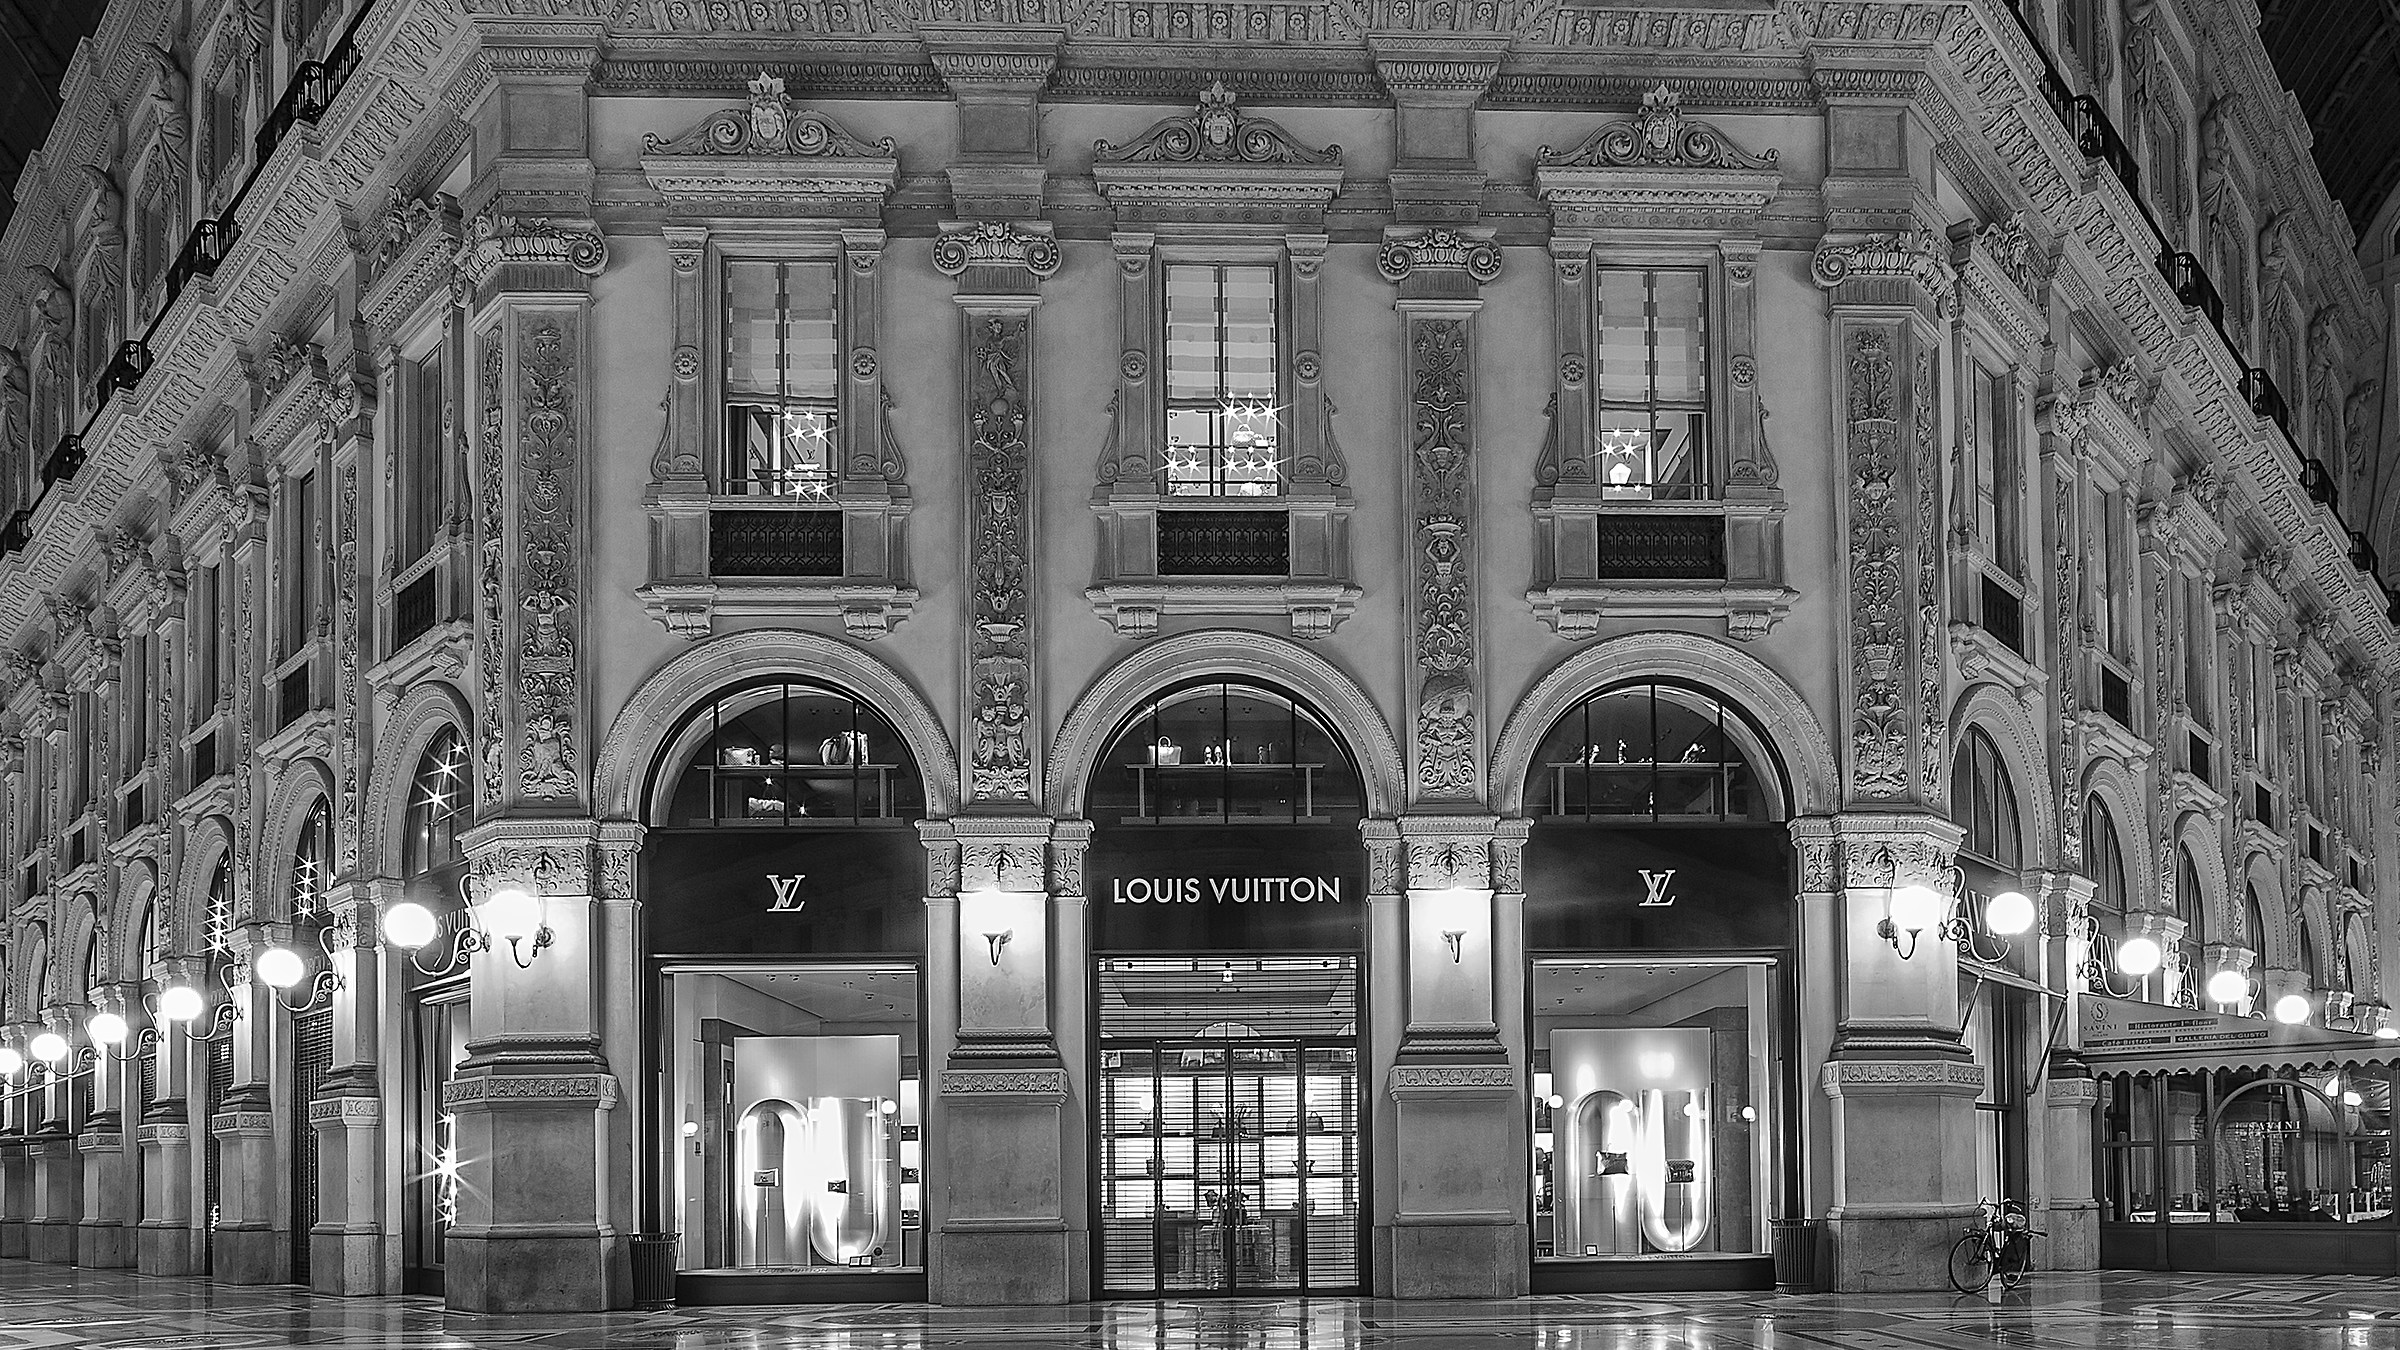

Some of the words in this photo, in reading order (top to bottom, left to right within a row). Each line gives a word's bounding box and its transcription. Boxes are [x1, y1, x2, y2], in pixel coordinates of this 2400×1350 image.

[1113, 877, 1200, 904] LOUIS
[1208, 876, 1341, 904] VUITTON
[2083, 1023, 2117, 1032] SAVINI
[2134, 1021, 2178, 1029] Ristorante
[2177, 1032, 2218, 1041] GALLERIA
[2219, 1032, 2236, 1040] DEL
[2237, 1030, 2267, 1039] GUSTO
